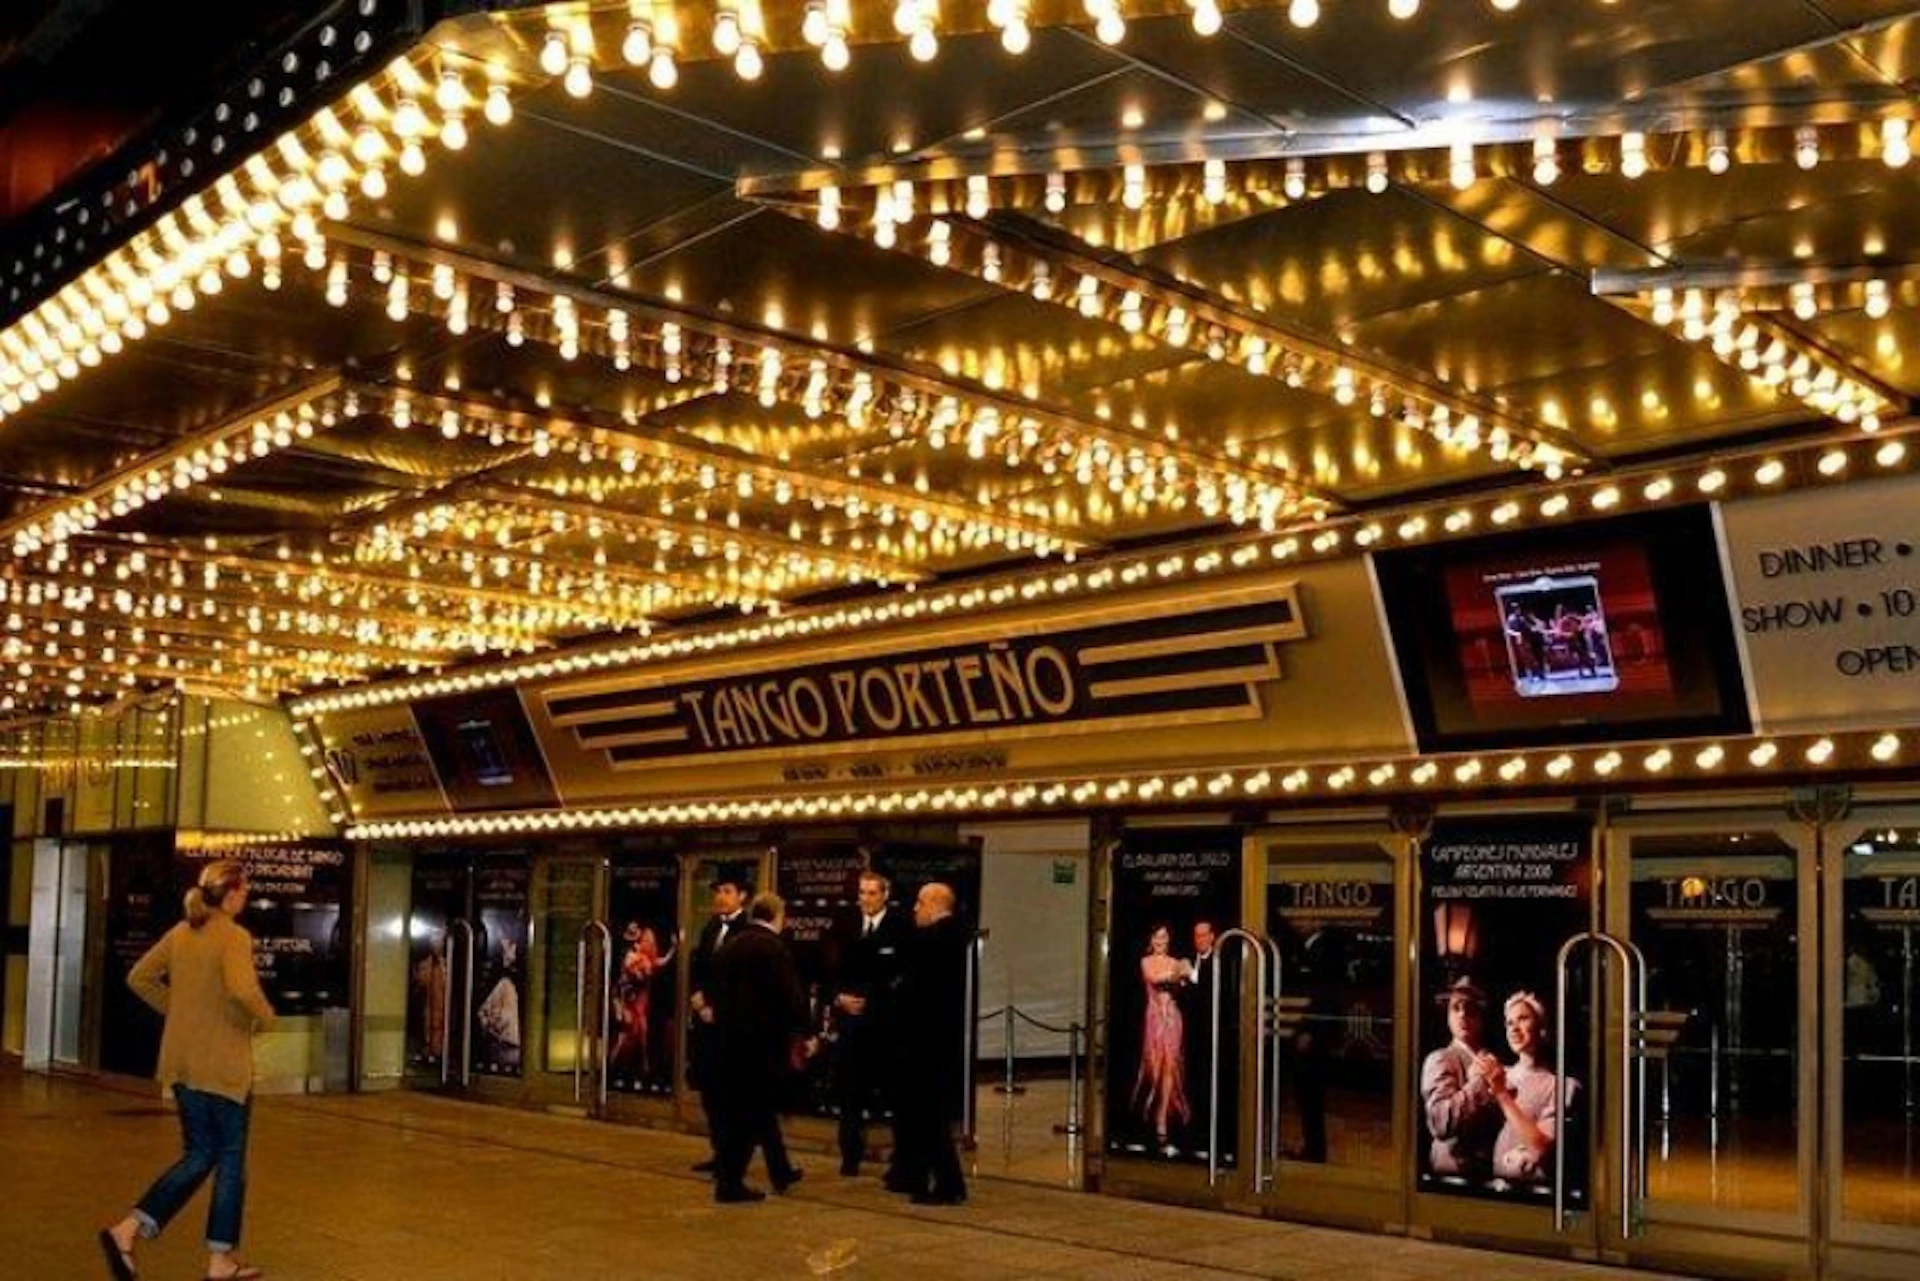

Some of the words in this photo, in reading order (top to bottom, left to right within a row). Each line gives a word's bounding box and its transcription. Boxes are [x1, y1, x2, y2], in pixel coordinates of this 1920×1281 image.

[1759, 538, 1882, 578] DINNER
[1742, 598, 1843, 633] SHOW
[681, 676, 828, 748] TANGO
[830, 642, 1074, 735] PORTEÑO
[1289, 882, 1373, 907] TANGO
